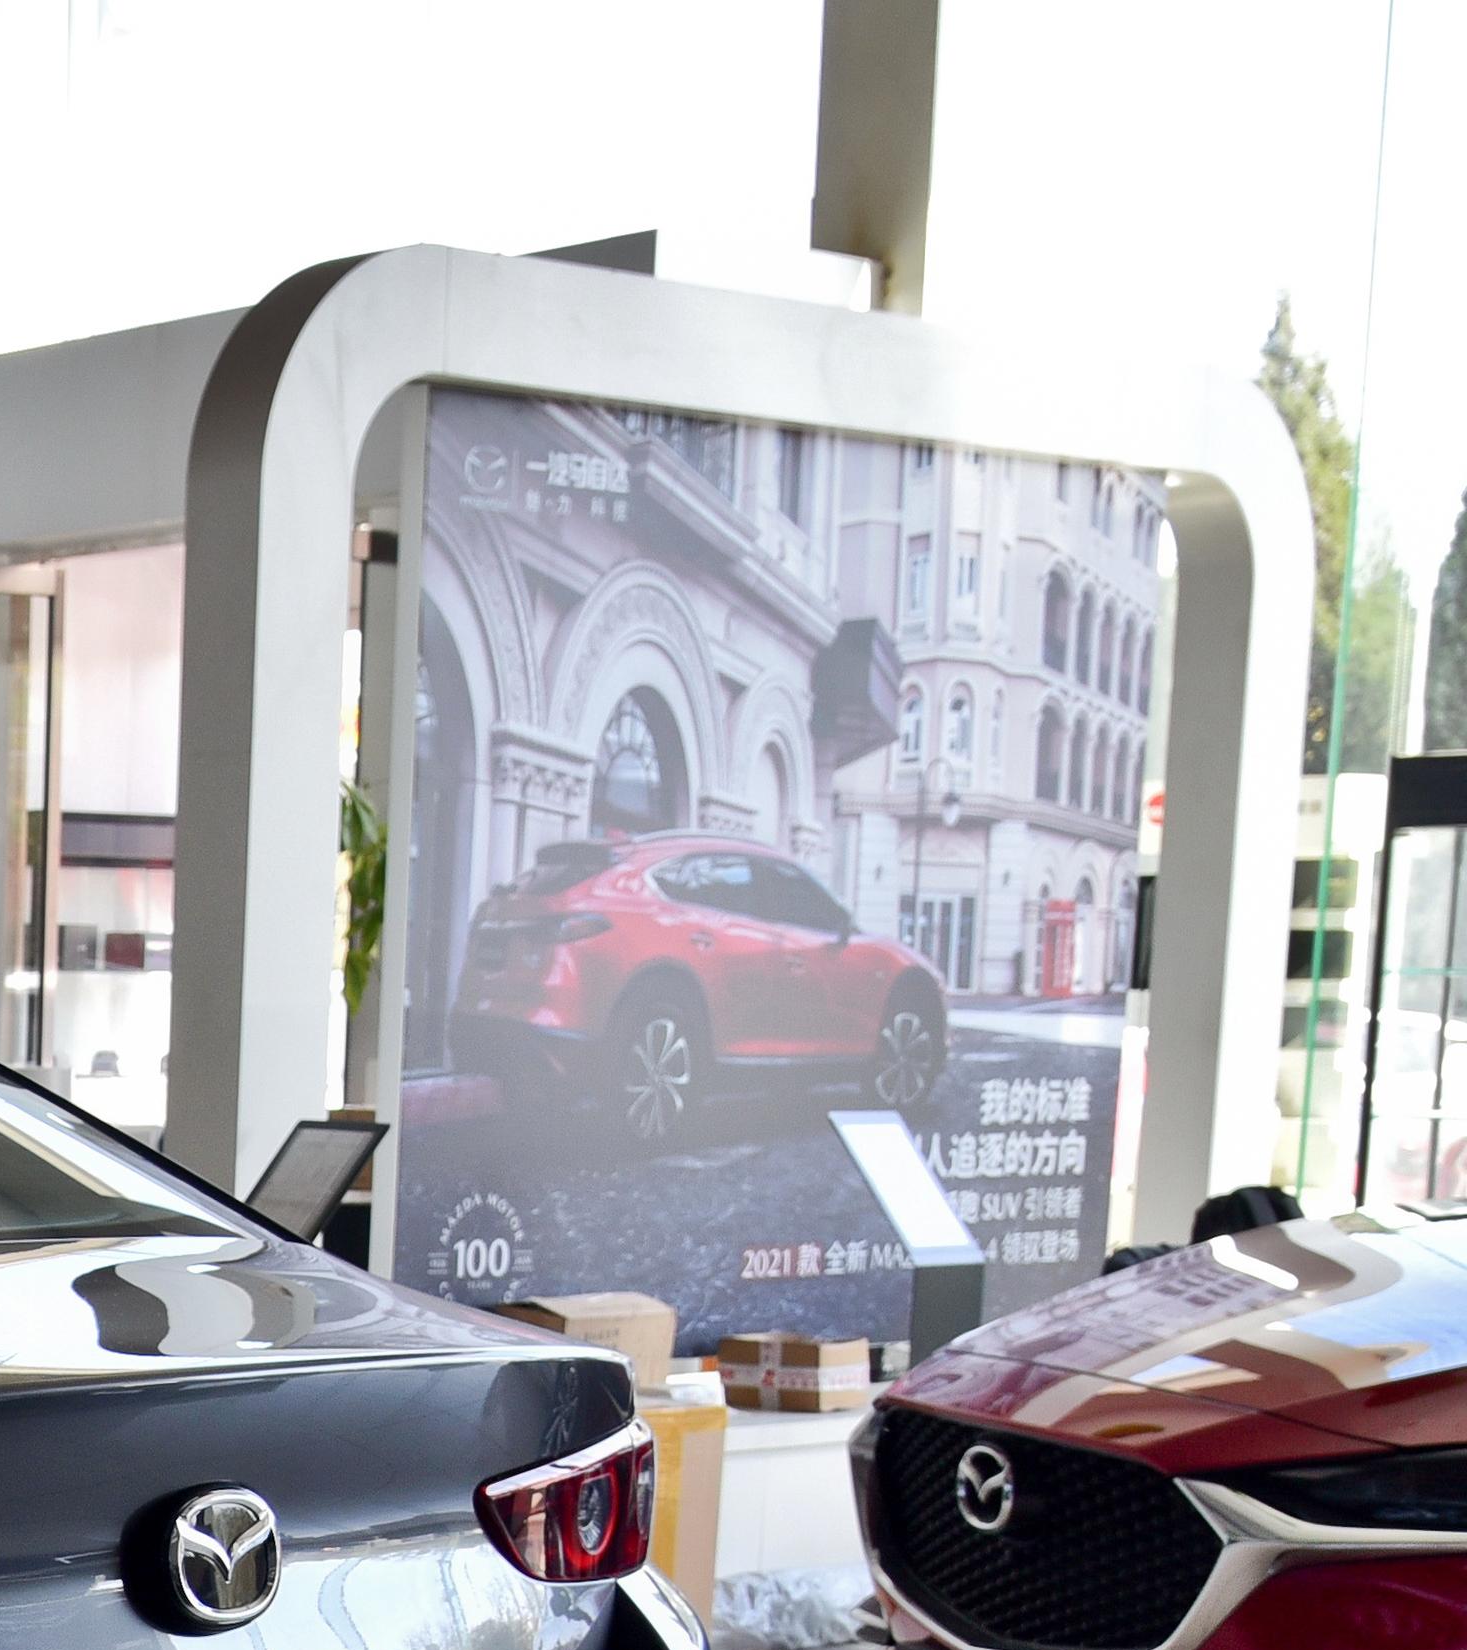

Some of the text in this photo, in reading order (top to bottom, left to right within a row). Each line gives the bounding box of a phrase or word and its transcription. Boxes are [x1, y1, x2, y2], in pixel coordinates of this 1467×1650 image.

[979, 1076, 1093, 1126] 我的标准
[916, 1128, 1087, 1179] 人追逐的方向
[452, 1237, 511, 1279] 100
[740, 1247, 791, 1280] 2021
[823, 1239, 867, 1276] 全新
